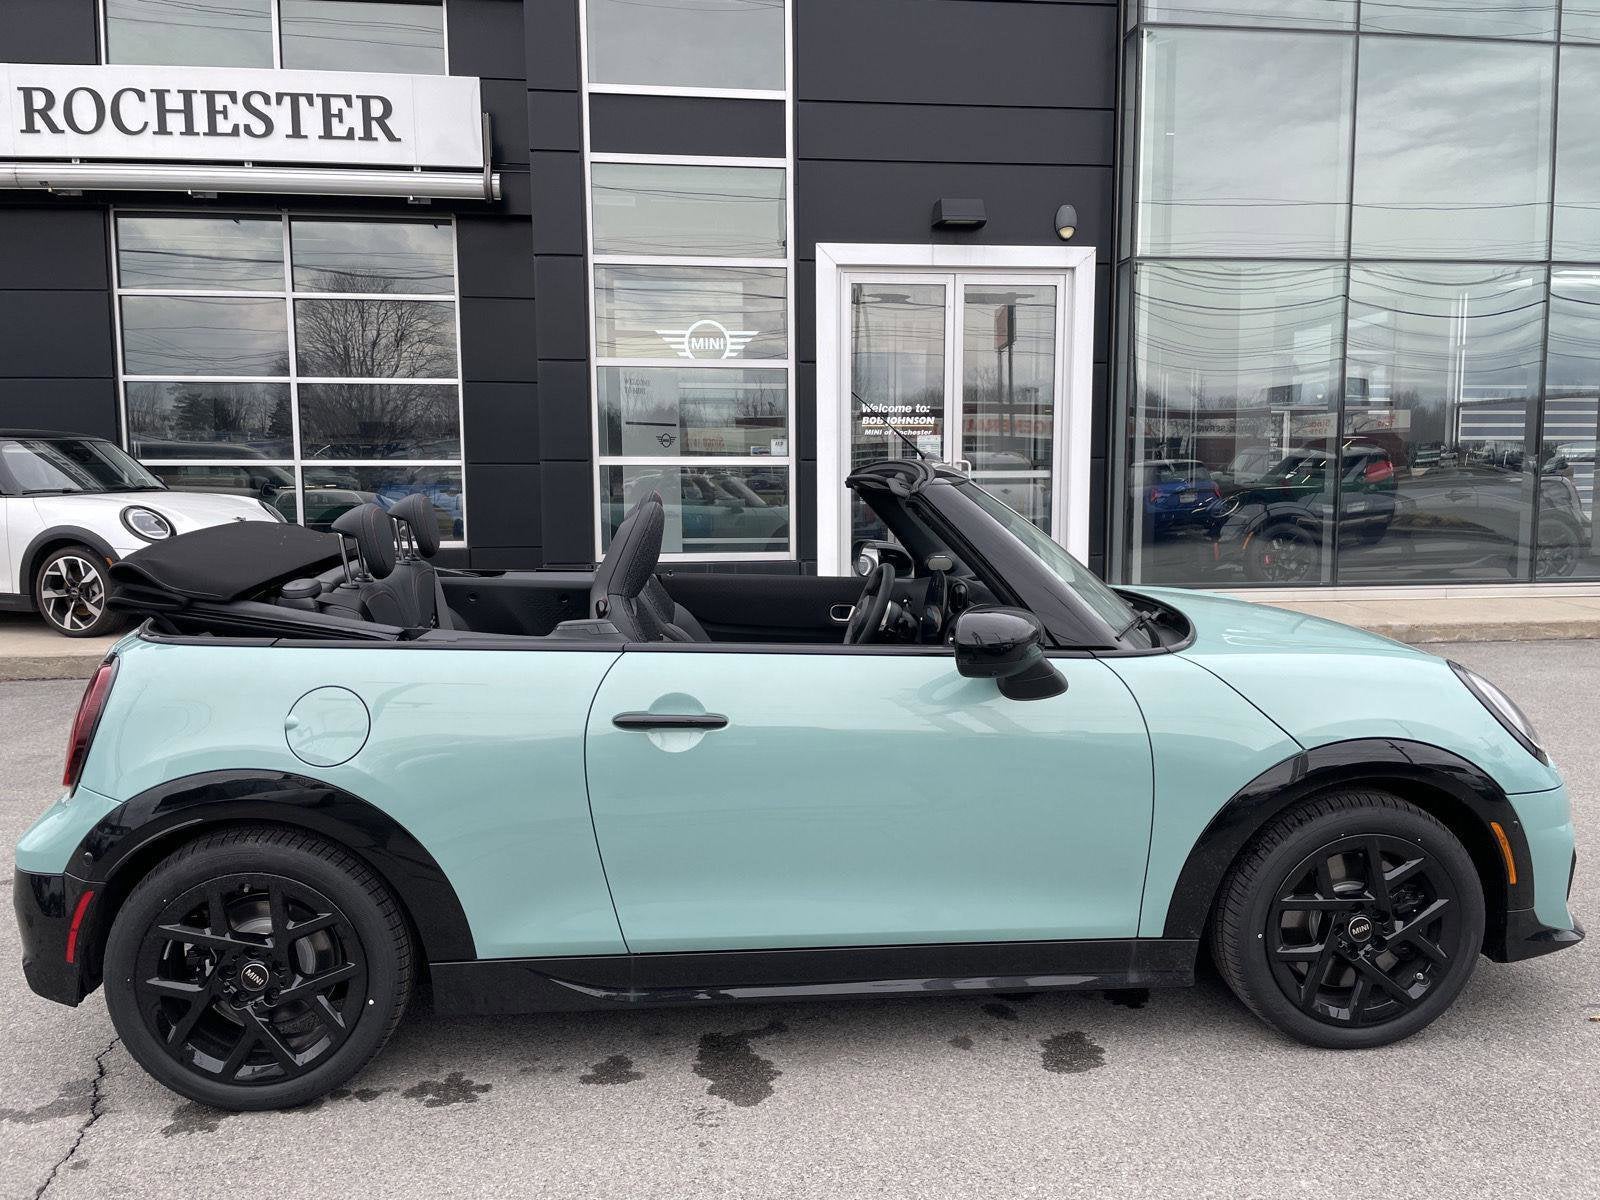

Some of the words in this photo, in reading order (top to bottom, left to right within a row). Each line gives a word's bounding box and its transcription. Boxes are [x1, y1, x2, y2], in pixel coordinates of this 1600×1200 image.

[17, 86, 402, 142] ROCHESTER
[691, 337, 724, 350] MINI
[862, 403, 913, 413] Welcome
[915, 404, 931, 413] to:
[862, 416, 884, 425] BOB
[885, 416, 935, 427] JOHNSON
[1351, 923, 1370, 935] MINI
[245, 968, 264, 985] MINI
